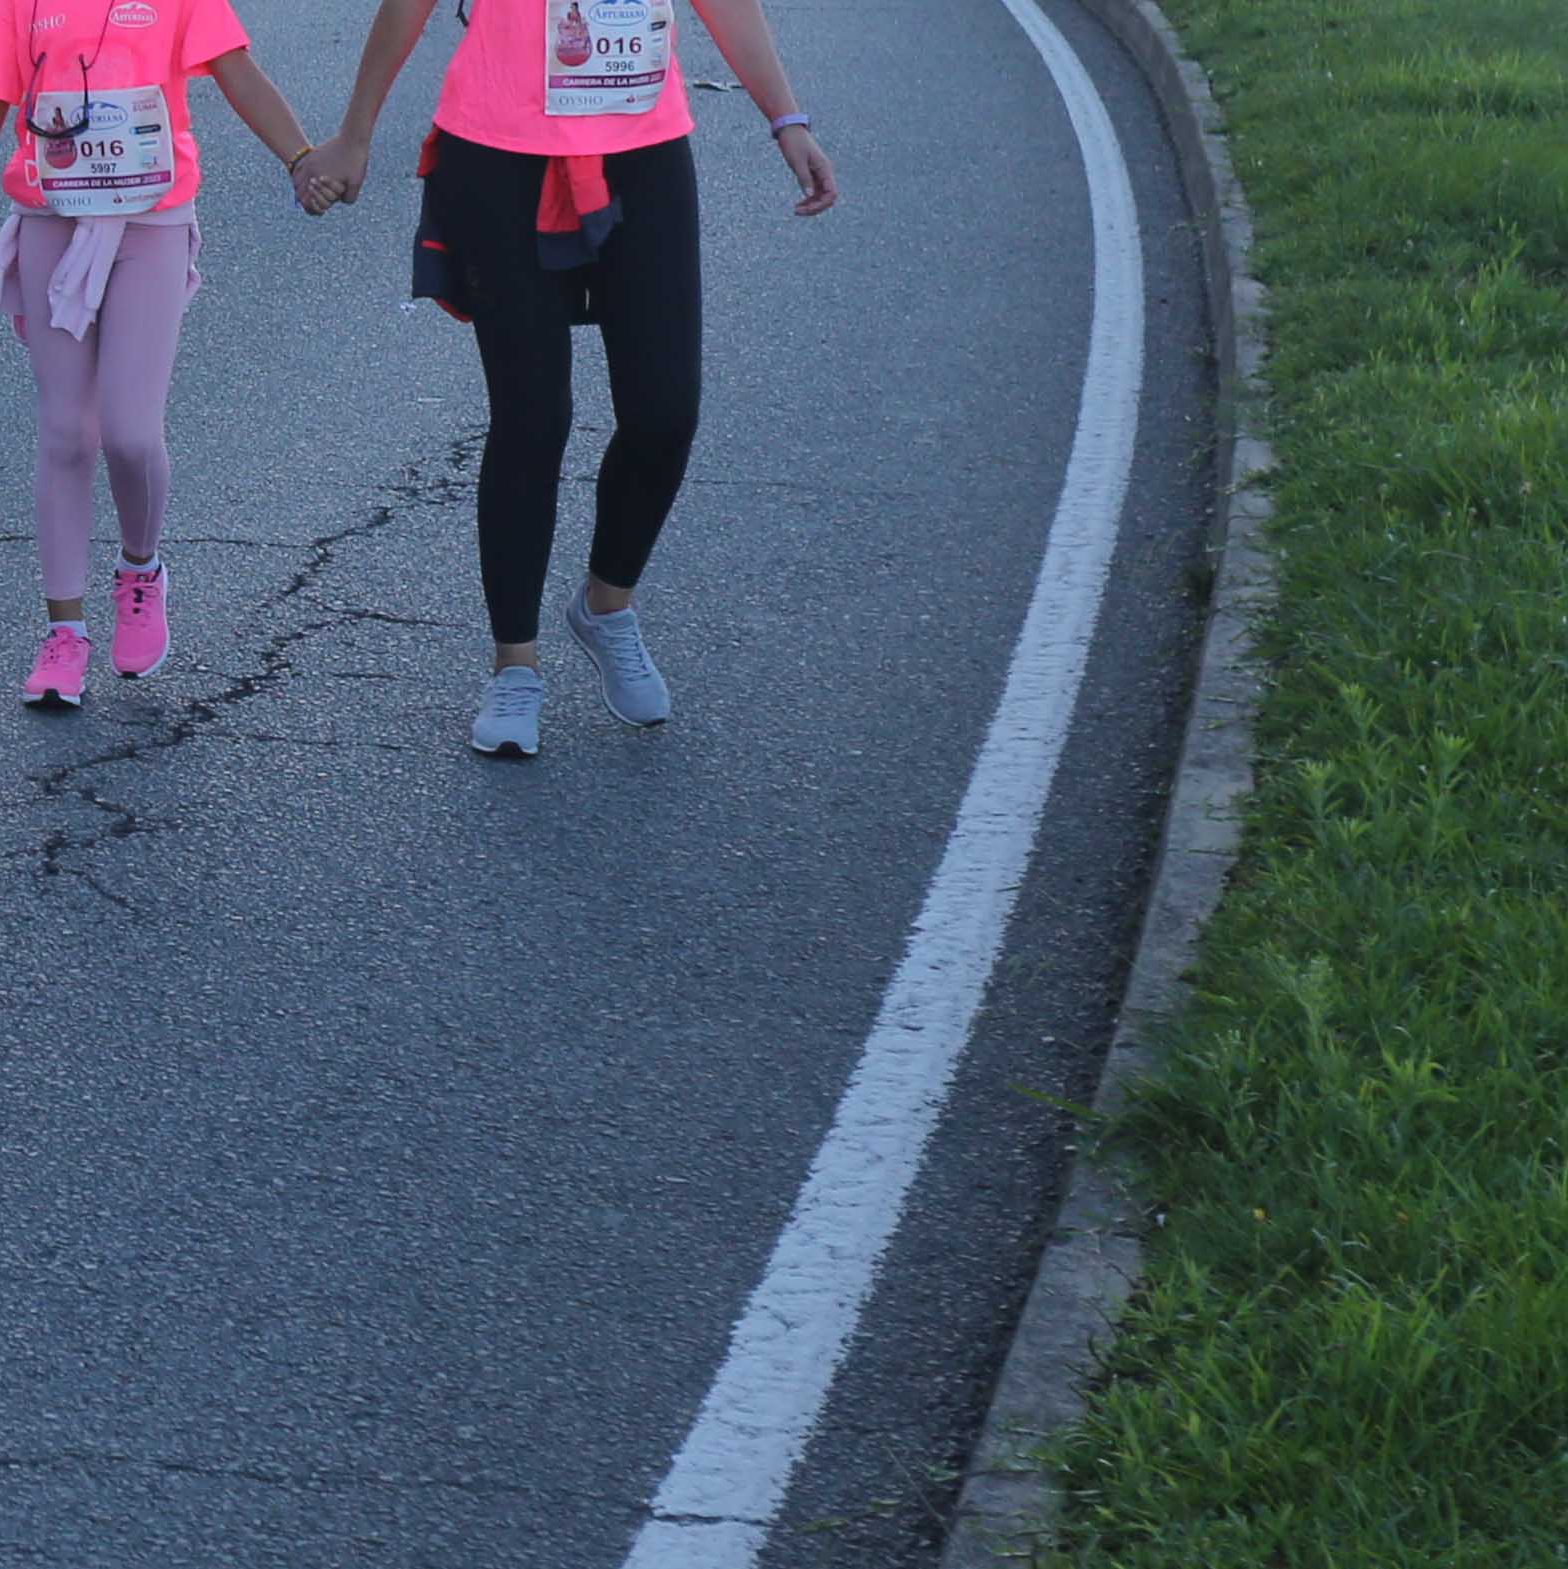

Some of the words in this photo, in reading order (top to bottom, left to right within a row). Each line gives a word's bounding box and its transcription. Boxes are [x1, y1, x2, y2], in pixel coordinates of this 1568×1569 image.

[596, 36, 643, 55] 016
[605, 60, 636, 73] 5996
[558, 95, 604, 106] OYSHO
[80, 140, 124, 157] 016
[90, 162, 117, 174] 5997
[52, 180, 90, 188] CARRERA
[91, 179, 102, 187] DE
